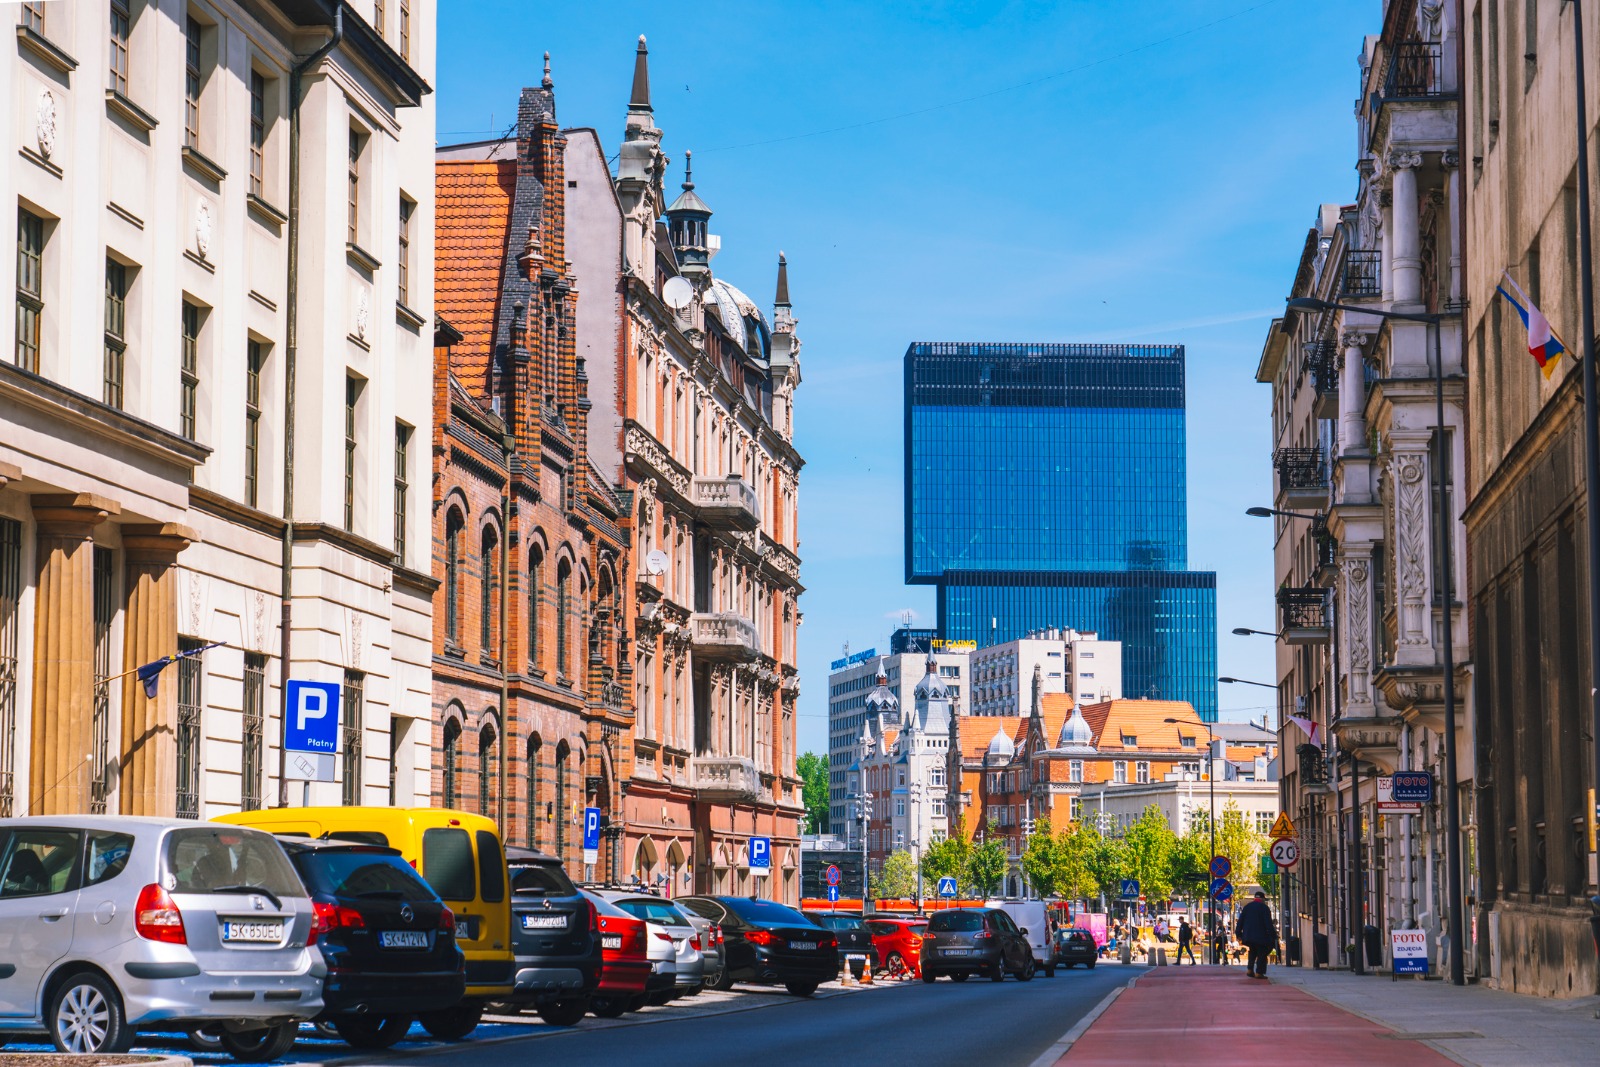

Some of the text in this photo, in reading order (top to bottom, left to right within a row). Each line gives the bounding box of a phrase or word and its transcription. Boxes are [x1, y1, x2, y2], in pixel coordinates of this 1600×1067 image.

[945, 639, 977, 649] CASINO
[297, 687, 328, 730] P
[307, 738, 334, 749] Płatny
[1396, 777, 1428, 786] FOTO
[588, 812, 597, 838] P
[753, 840, 766, 859] P
[1275, 846, 1296, 860] 20
[231, 922, 246, 938] SK
[1393, 934, 1425, 943] FOTO
